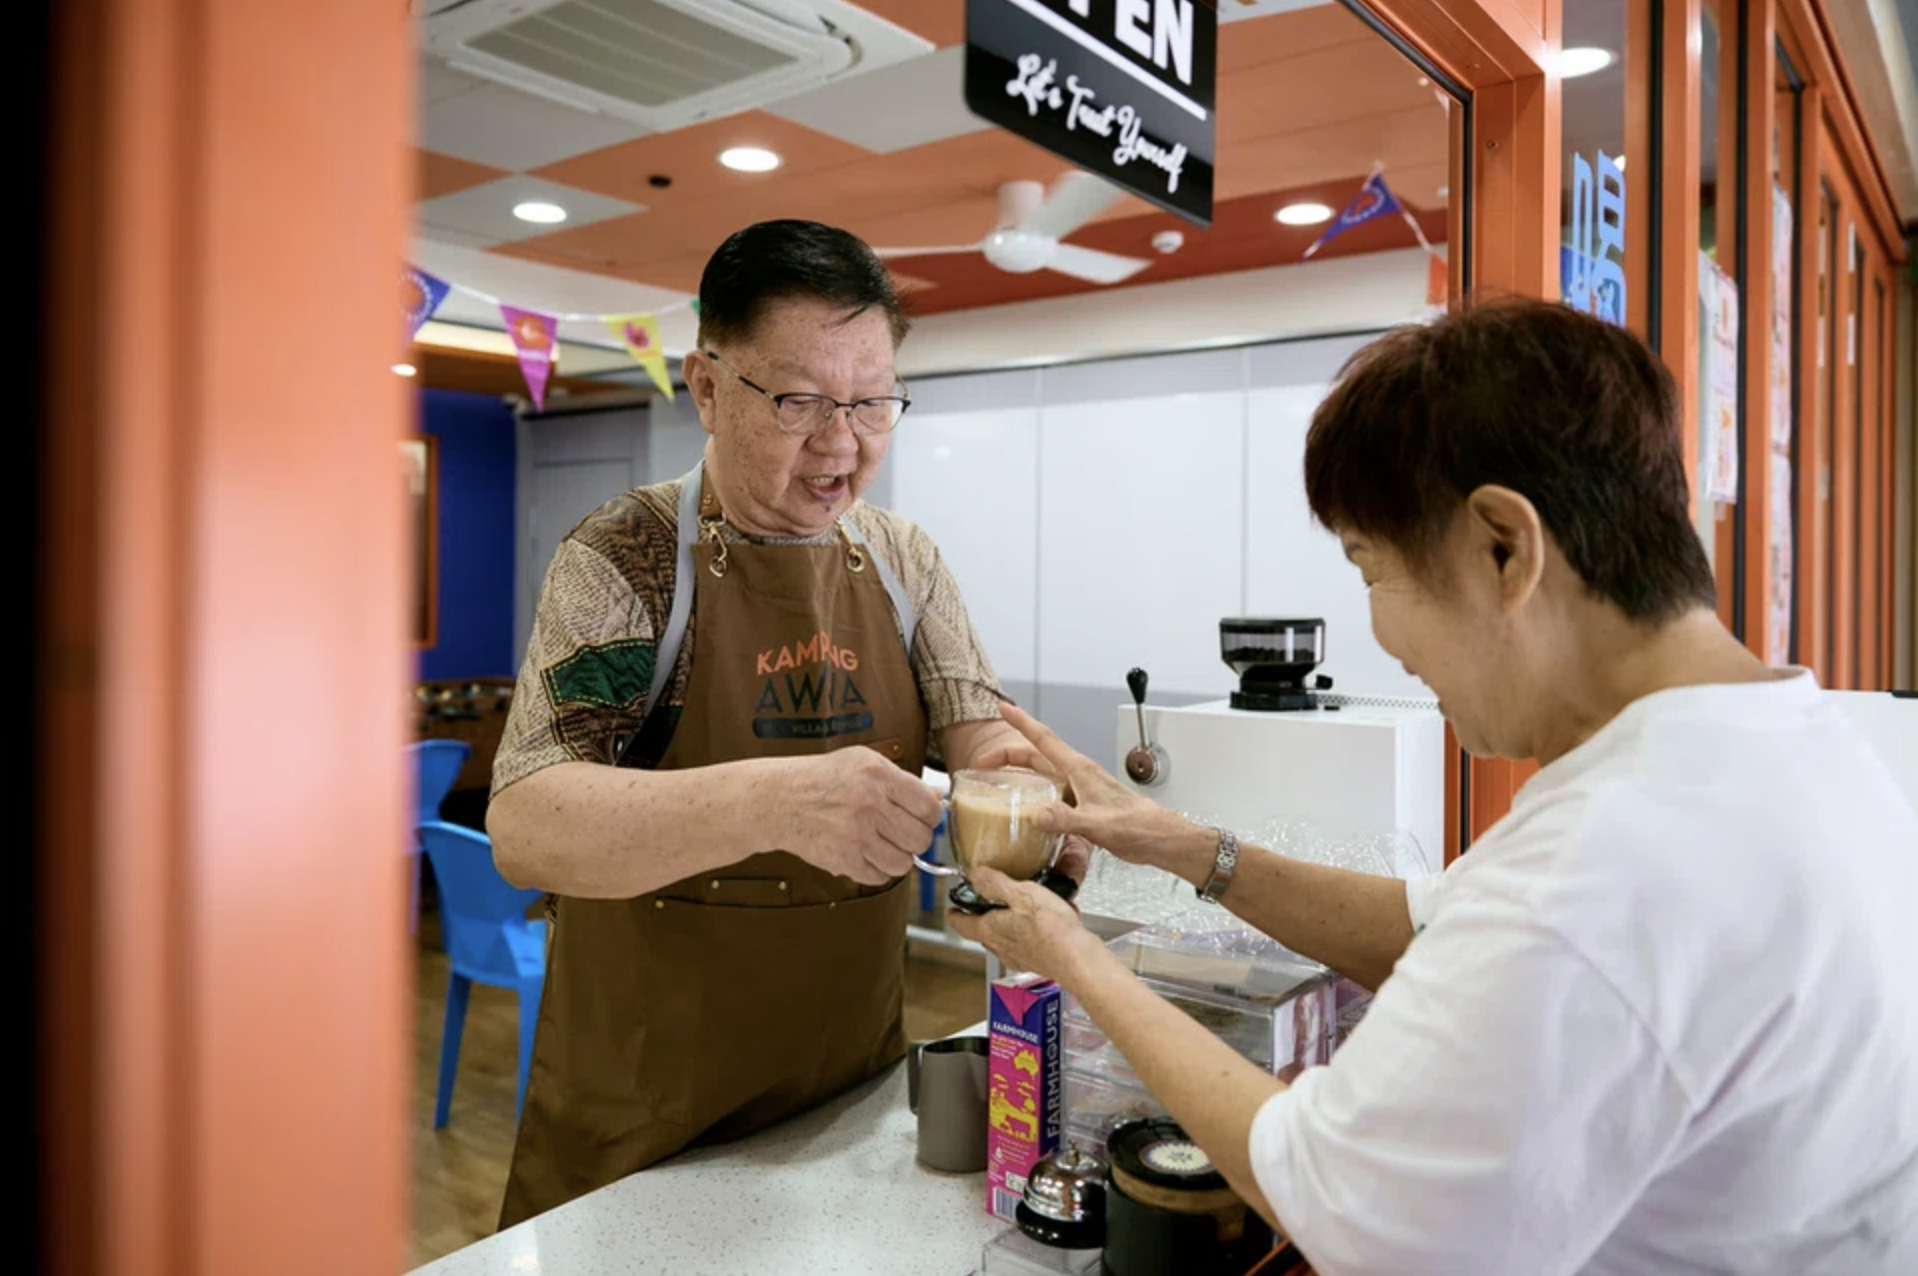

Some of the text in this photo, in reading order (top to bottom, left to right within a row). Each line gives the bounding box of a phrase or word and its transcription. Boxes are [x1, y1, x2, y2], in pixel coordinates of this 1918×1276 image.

[1068, 0, 1194, 86] EN
[757, 629, 859, 675] KAMPNG
[992, 1021, 1039, 1044] FARMHOUSE
[1046, 999, 1060, 1139] FARMHOUSE
